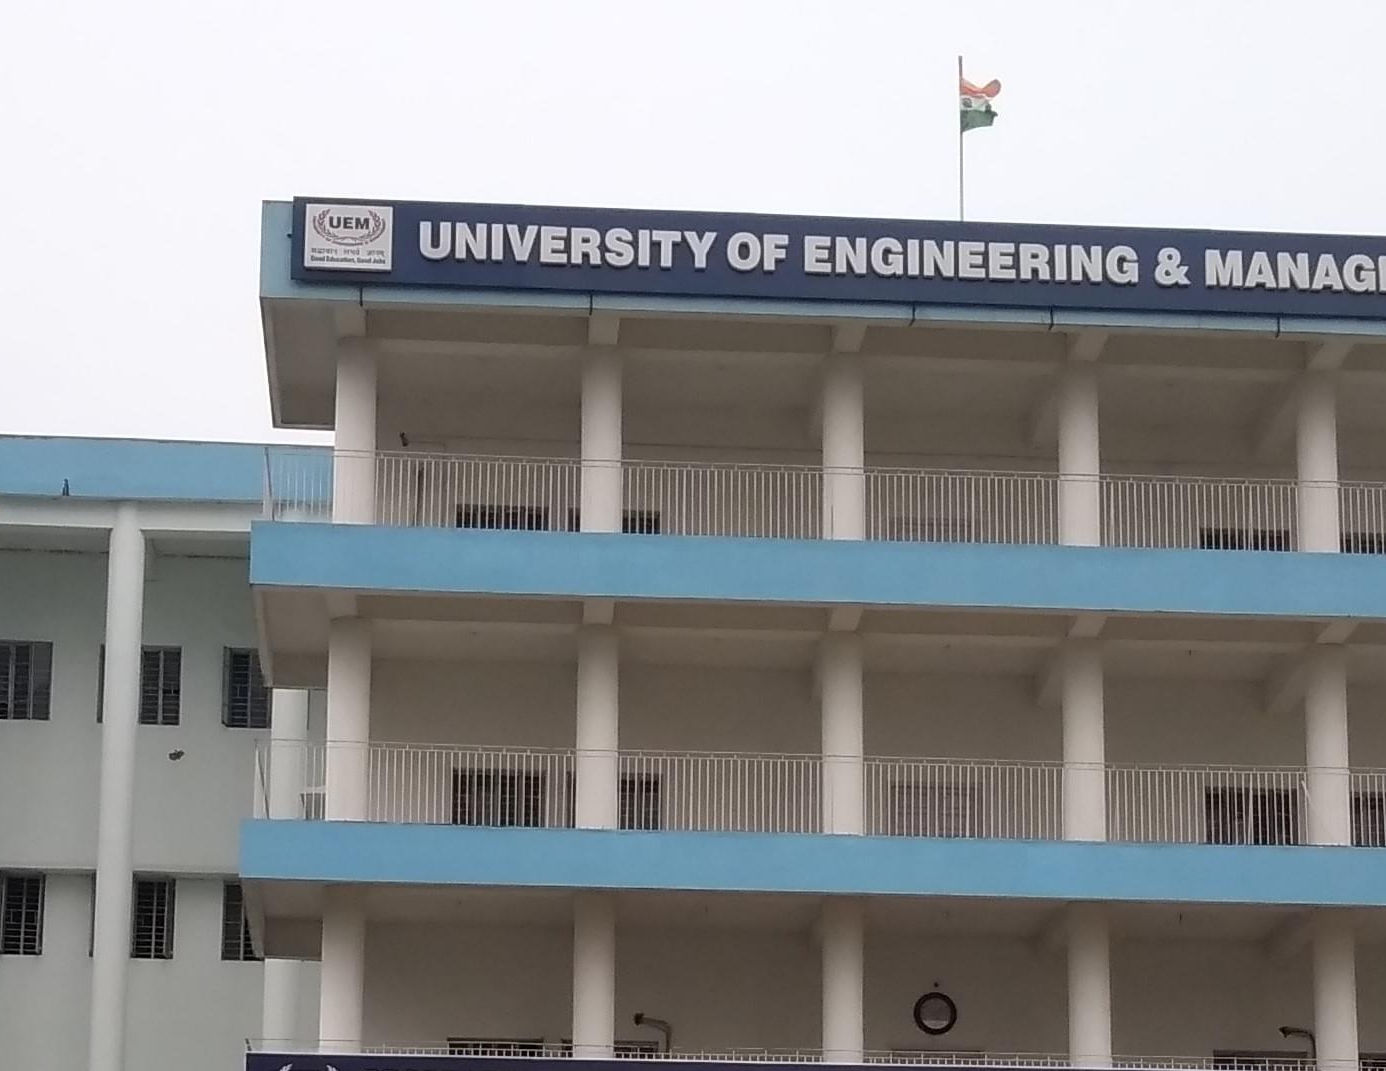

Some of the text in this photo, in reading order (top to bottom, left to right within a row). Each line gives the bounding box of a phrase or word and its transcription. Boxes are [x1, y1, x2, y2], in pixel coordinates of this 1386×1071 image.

[328, 215, 370, 230] UEM
[419, 220, 717, 269] UNIVERSITY
[727, 231, 788, 271] OF
[804, 235, 1139, 285] ENGINEERING
[1154, 247, 1191, 286] &
